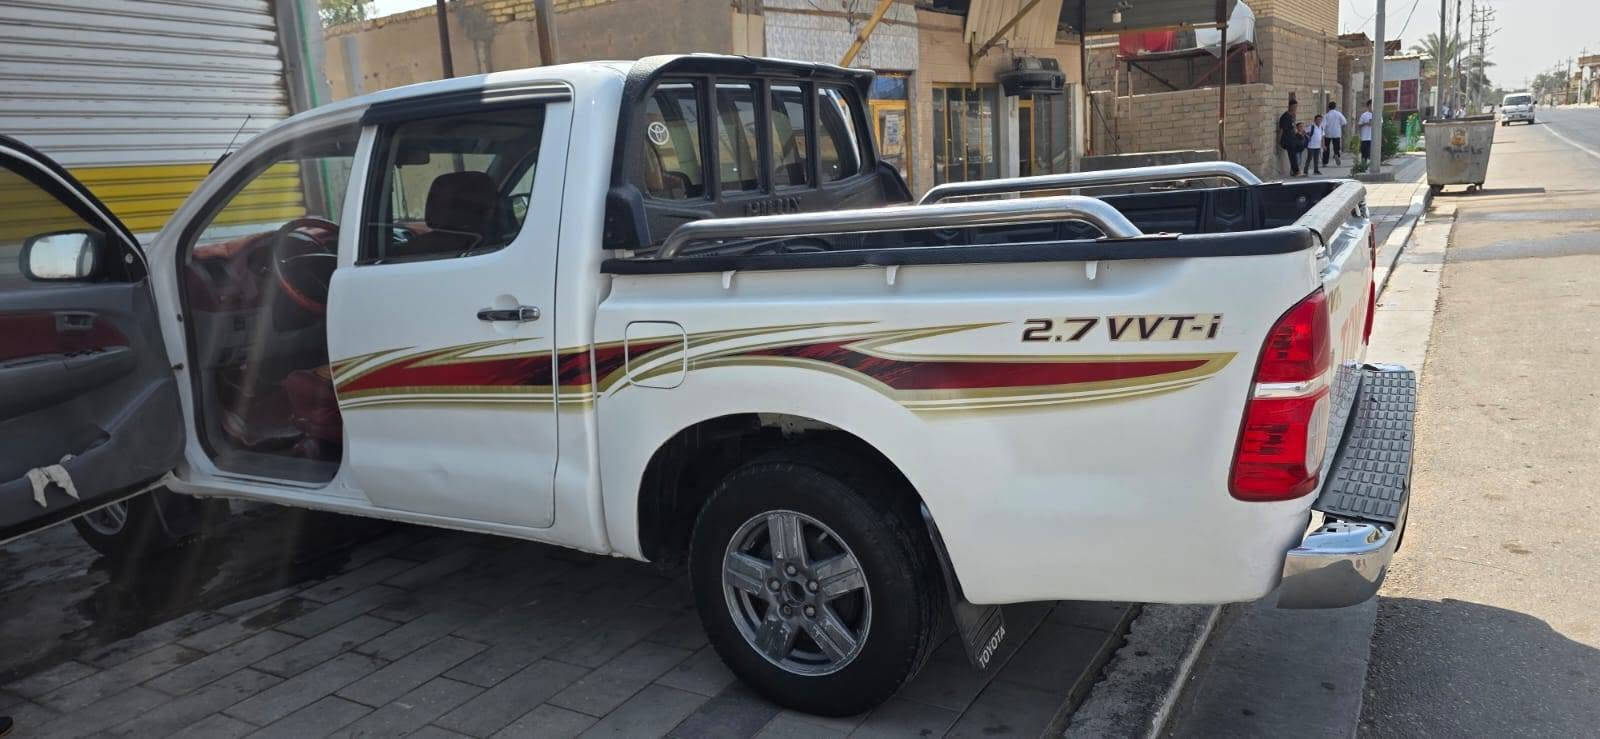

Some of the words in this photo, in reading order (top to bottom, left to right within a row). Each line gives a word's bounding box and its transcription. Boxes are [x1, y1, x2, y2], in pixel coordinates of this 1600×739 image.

[1021, 316, 1099, 342] 2.7
[1107, 314, 1222, 341] VVT-i
[978, 625, 1006, 669] TOYOTA
